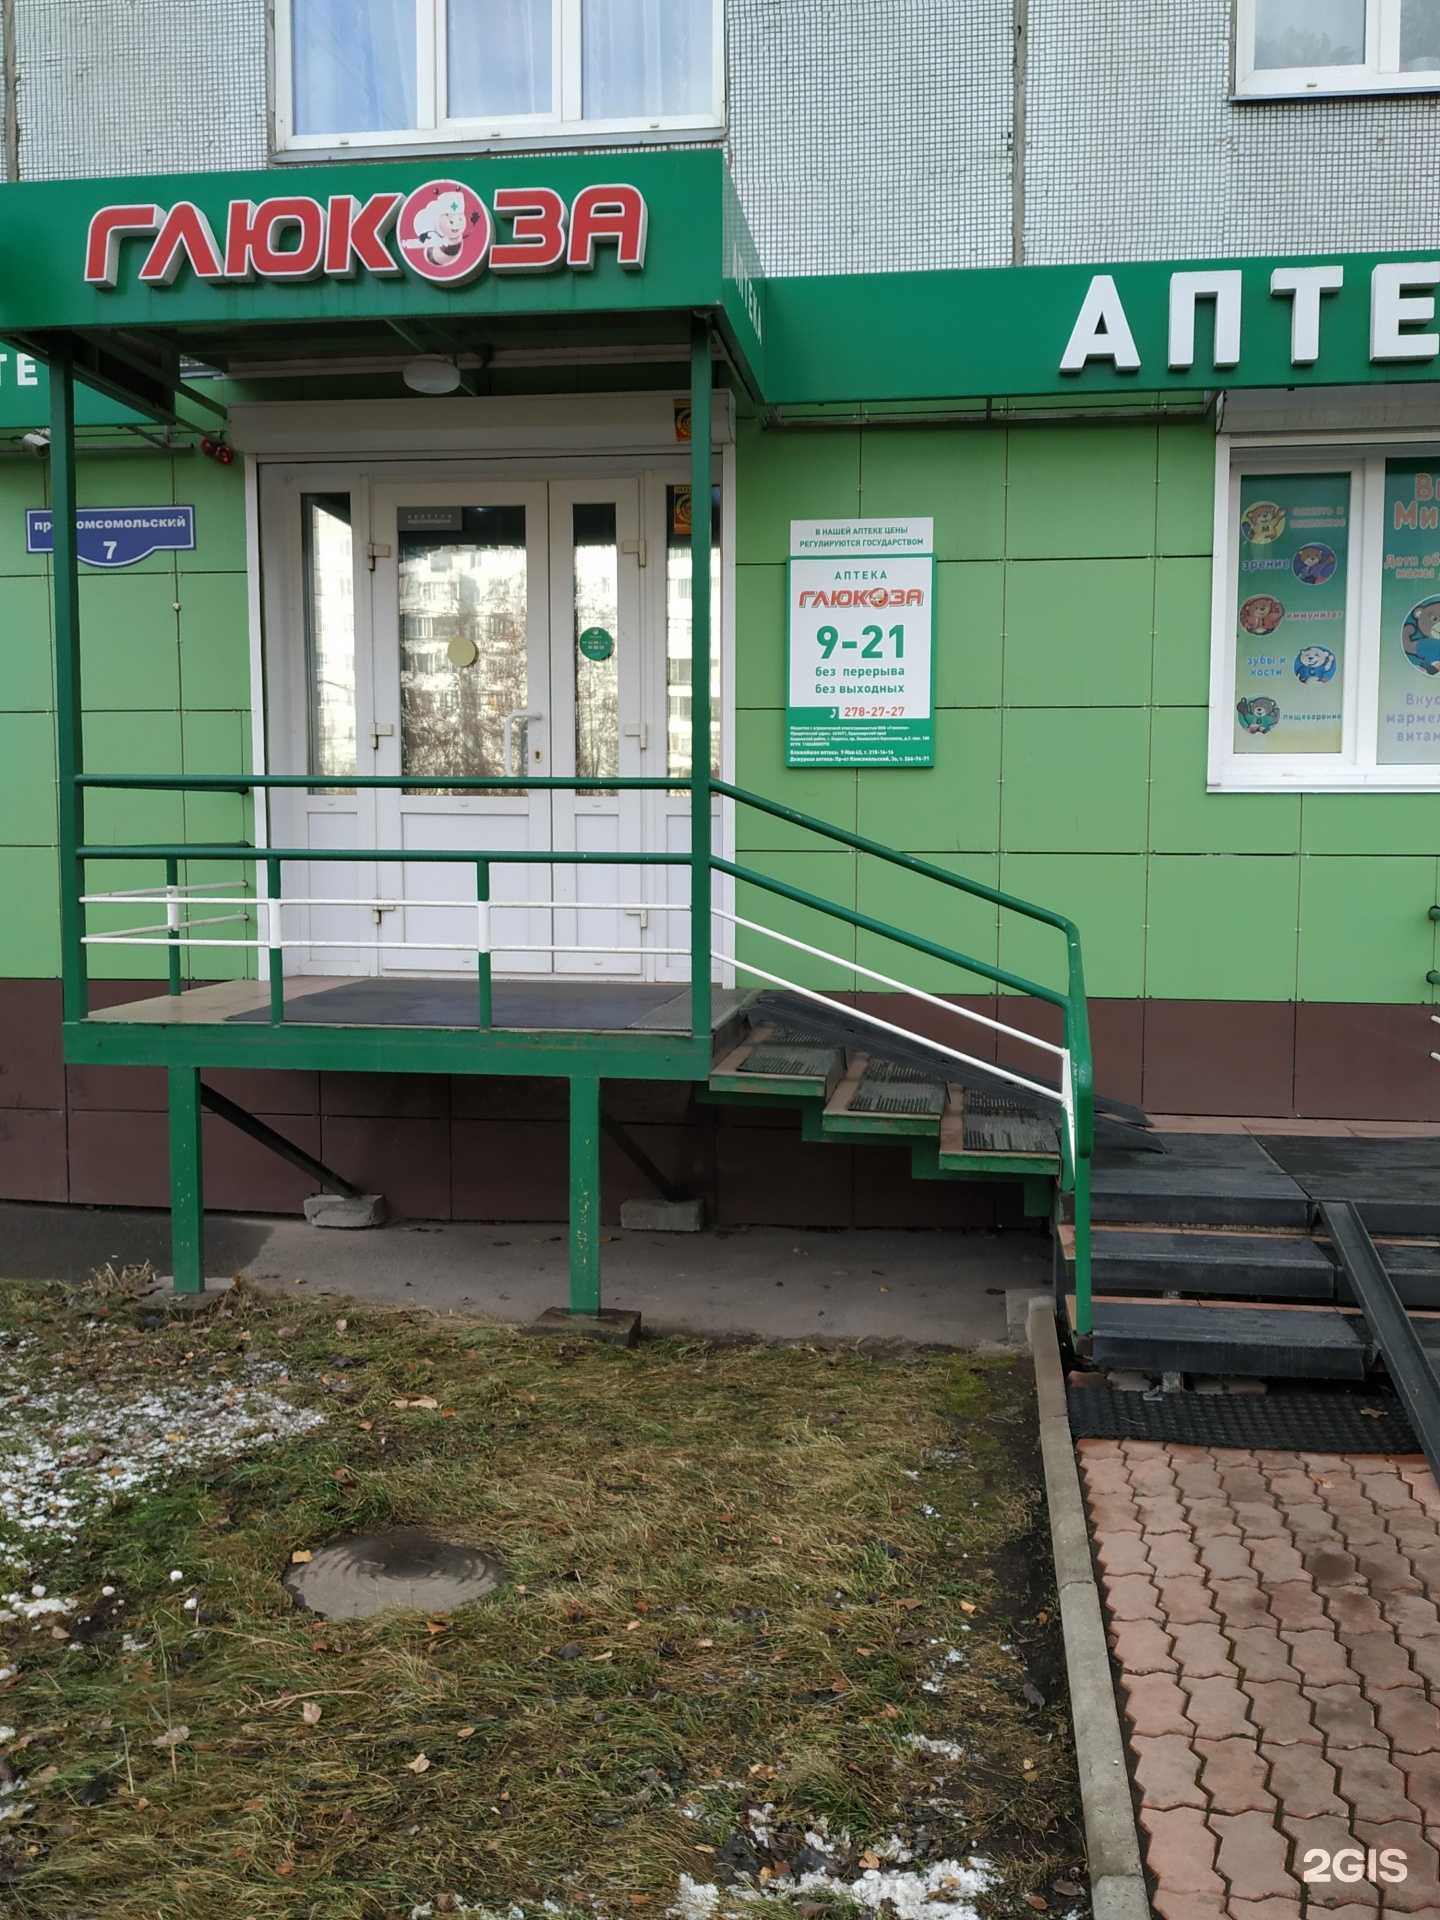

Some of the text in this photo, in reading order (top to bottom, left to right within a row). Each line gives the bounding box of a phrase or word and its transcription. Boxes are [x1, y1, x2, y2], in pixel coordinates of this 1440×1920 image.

[84, 178, 648, 288] ГЛЮКОЗА
[1058, 262, 1440, 374] АПТЕ
[76, 515, 187, 529] омсомольский
[822, 526, 851, 536] НАШЕЙ
[853, 527, 883, 535] АПТЕКЕ
[885, 527, 908, 535] ЦЕНЫ
[800, 538, 923, 548] РЕГУЛИРУЮТСЯ ГОСУДАРСТВОМ
[103, 541, 118, 560] 7
[834, 570, 888, 580] АПТЕКА
[799, 587, 924, 609] ГЛЮКОЗА
[816, 624, 905, 660] 9-21
[815, 666, 905, 678] без перерыва
[815, 684, 905, 694] без выходных
[844, 706, 905, 717] 278-27-27
